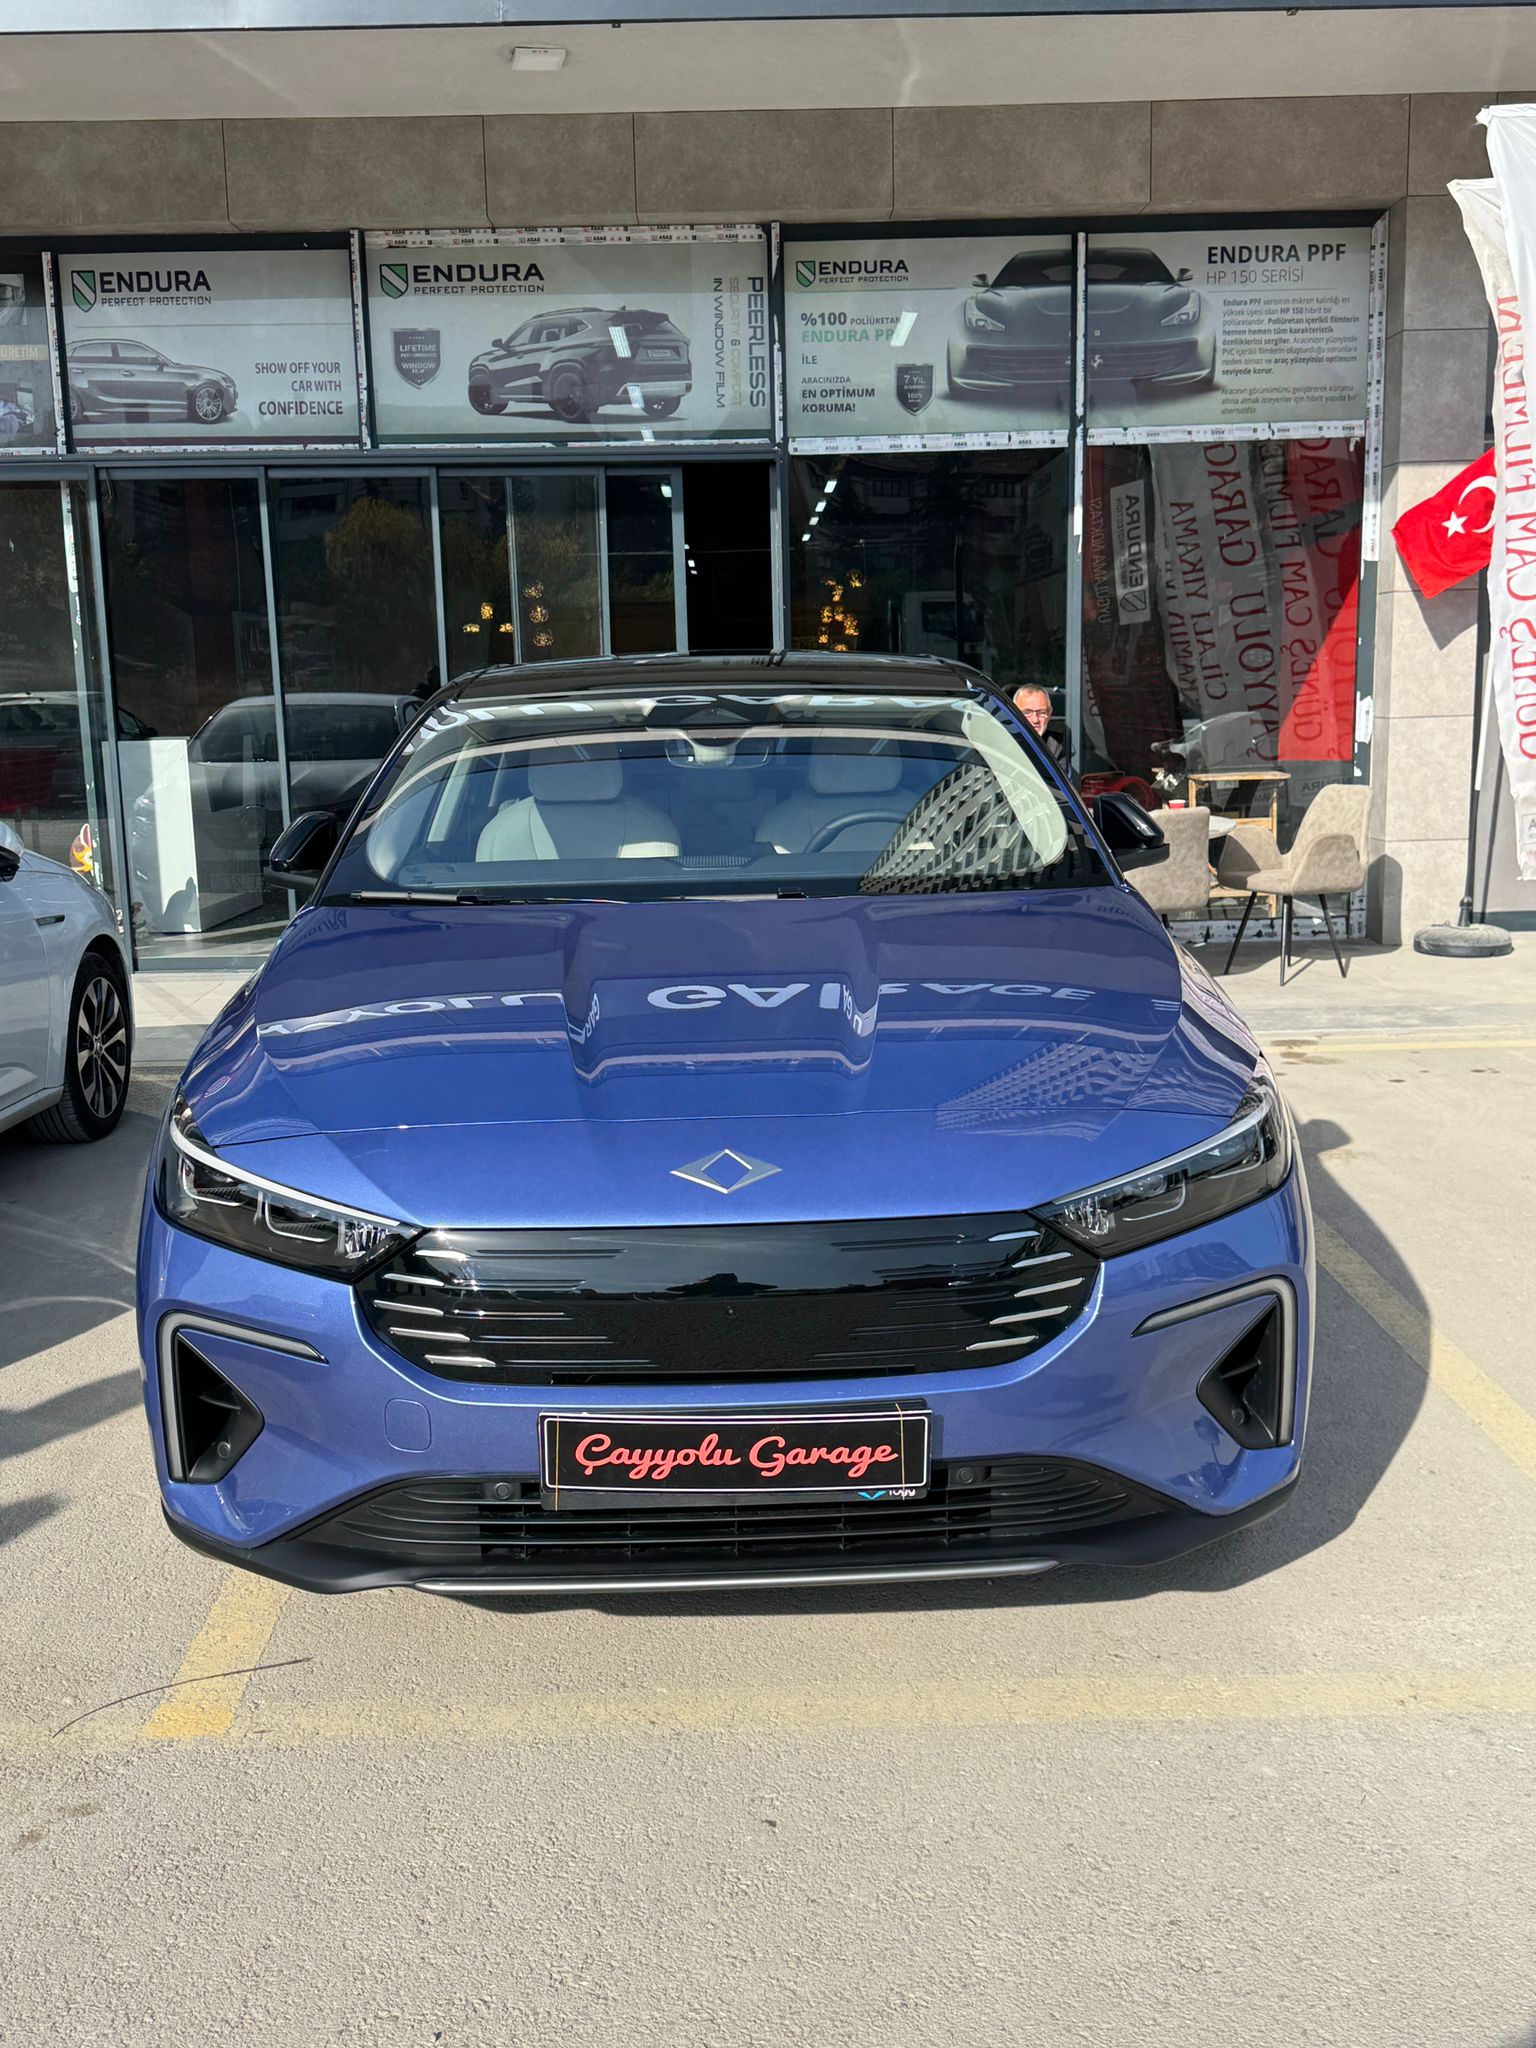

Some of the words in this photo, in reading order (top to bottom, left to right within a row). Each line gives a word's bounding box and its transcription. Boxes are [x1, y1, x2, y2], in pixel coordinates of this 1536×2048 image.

[1208, 245, 1300, 264] ENDURA
[1307, 243, 1347, 262] PPF
[414, 263, 545, 284] ENDURA
[819, 260, 909, 275] ENDURA
[858, 275, 909, 283] PROTECTION
[1206, 270, 1226, 284] HP
[1231, 269, 1257, 284] 150
[1261, 266, 1304, 283] SERİSİ
[100, 270, 212, 294] ENDURA
[713, 277, 723, 292] IN
[414, 285, 465, 295] PERFECT
[470, 284, 545, 294] PROTECTION
[101, 297, 146, 308] PERFECT
[150, 295, 212, 307] PROTECTION
[1223, 299, 1248, 307] Endura
[1249, 298, 1262, 306] PPF
[1280, 307, 1290, 315] HP
[800, 311, 847, 327] %100
[713, 295, 725, 368] WINDOW
[801, 328, 869, 343] ENDURA
[1222, 328, 1246, 336] hemen
[1248, 327, 1272, 336] hemen
[1273, 327, 1288, 335] tüm
[1289, 326, 1334, 334] karakteristik
[399, 344, 438, 352] LIFETIME
[731, 338, 741, 347] &
[747, 276, 766, 408] PEERLESS
[801, 354, 818, 365] İLE
[1273, 357, 1289, 366] araç
[255, 362, 288, 375] SHOW
[289, 362, 310, 374] OFF
[311, 362, 341, 374] YOUR
[291, 380, 313, 393] CAR
[314, 380, 342, 392] WITH
[801, 376, 852, 385] ARACINIZDA
[715, 371, 726, 408] FILM
[801, 389, 818, 399] EN
[821, 387, 875, 399] OPTİMUM
[258, 400, 344, 416] CONFIDENCE
[802, 403, 856, 413] KORUMA!
[575, 1433, 742, 1480] Çayyolu
[748, 1435, 900, 1478] Garage
